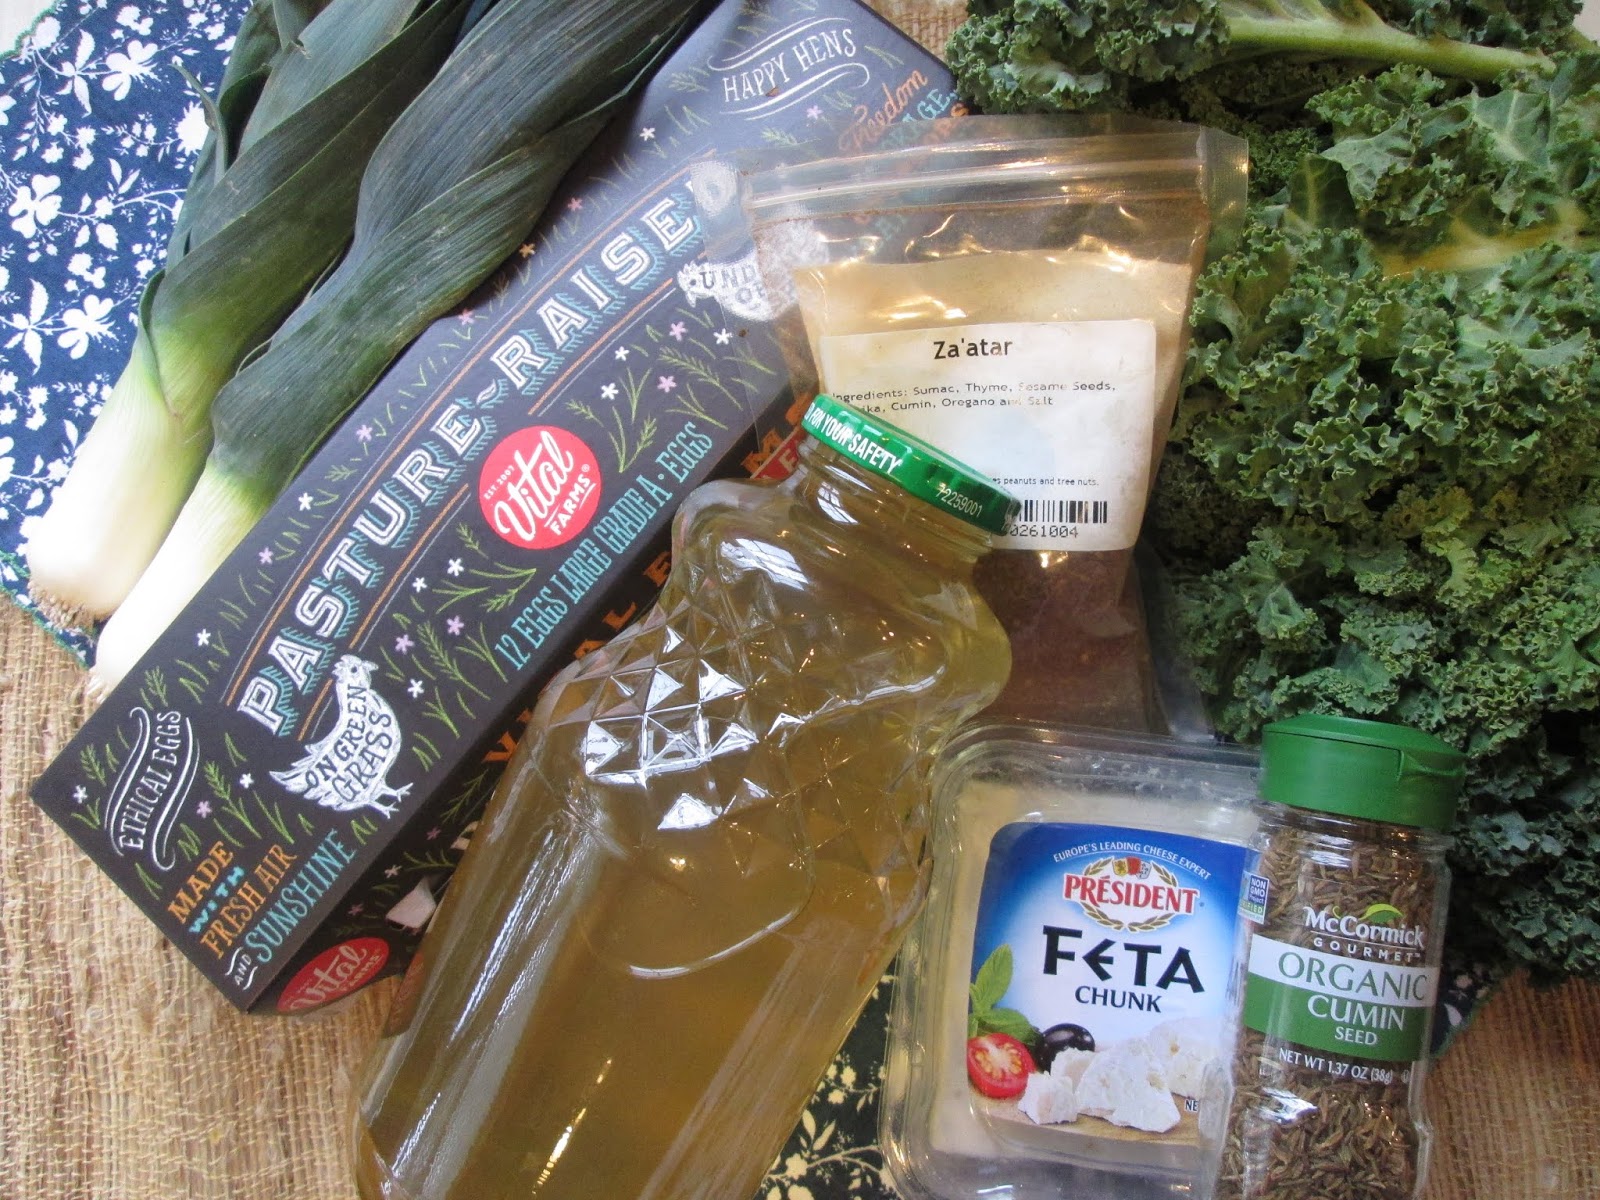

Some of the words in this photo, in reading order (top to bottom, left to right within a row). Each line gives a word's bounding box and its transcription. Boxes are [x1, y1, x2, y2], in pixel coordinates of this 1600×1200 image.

[721, 53, 791, 102] HAPPY
[792, 28, 857, 72] HENS
[932, 338, 1014, 360] Za'atar
[891, 400, 936, 411] Cumin,
[941, 396, 995, 408] Oregano
[913, 386, 959, 396] Sumac,
[965, 382, 1013, 394] Thyme,
[1072, 380, 1116, 391] Seeds,
[655, 420, 713, 484] EGGS
[821, 413, 853, 447] YOUR
[847, 433, 899, 475] SAFETY
[494, 430, 574, 541] Vital
[550, 474, 592, 536] FARMS
[636, 474, 673, 507] A
[1003, 477, 1037, 486] peanuts
[1040, 476, 1055, 485] and
[1058, 478, 1075, 486] tree
[1077, 478, 1100, 486] nuts.
[592, 487, 657, 555] GRADE
[550, 538, 612, 605] LARGE
[510, 585, 568, 649] EGGS
[494, 632, 532, 671] 12
[305, 755, 338, 793] ON
[333, 683, 367, 761] GREEN
[332, 711, 393, 801] GRASS
[119, 765, 173, 850] ETHICAL
[152, 711, 182, 766] EGGS
[168, 840, 234, 925] MADE
[1053, 842, 1098, 863] EUROPE'S
[1099, 841, 1141, 852] LEADING
[1143, 844, 1178, 862] CHEESE
[1178, 856, 1212, 880] EXPERT
[200, 881, 266, 960] FRESH
[254, 844, 298, 893] AIR
[234, 953, 252, 986] AND
[245, 828, 357, 964] SUNSHINE
[1064, 873, 1199, 914] PRÉSIDENT
[1303, 906, 1425, 949] McCormick
[1042, 924, 1206, 994] FETA
[1278, 952, 1429, 1001] ORGANIC
[1074, 985, 1162, 1013] CHUNK
[1307, 994, 1406, 1031] CUMIN
[1334, 1026, 1378, 1046] SEED
[1279, 1047, 1302, 1065] NET
[1304, 1054, 1326, 1072] WT
[1328, 1060, 1350, 1076] 1.37
[1351, 1065, 1368, 1080] OZ
[1370, 1068, 1393, 1085] (38g)
[1185, 1099, 1200, 1112] NE
